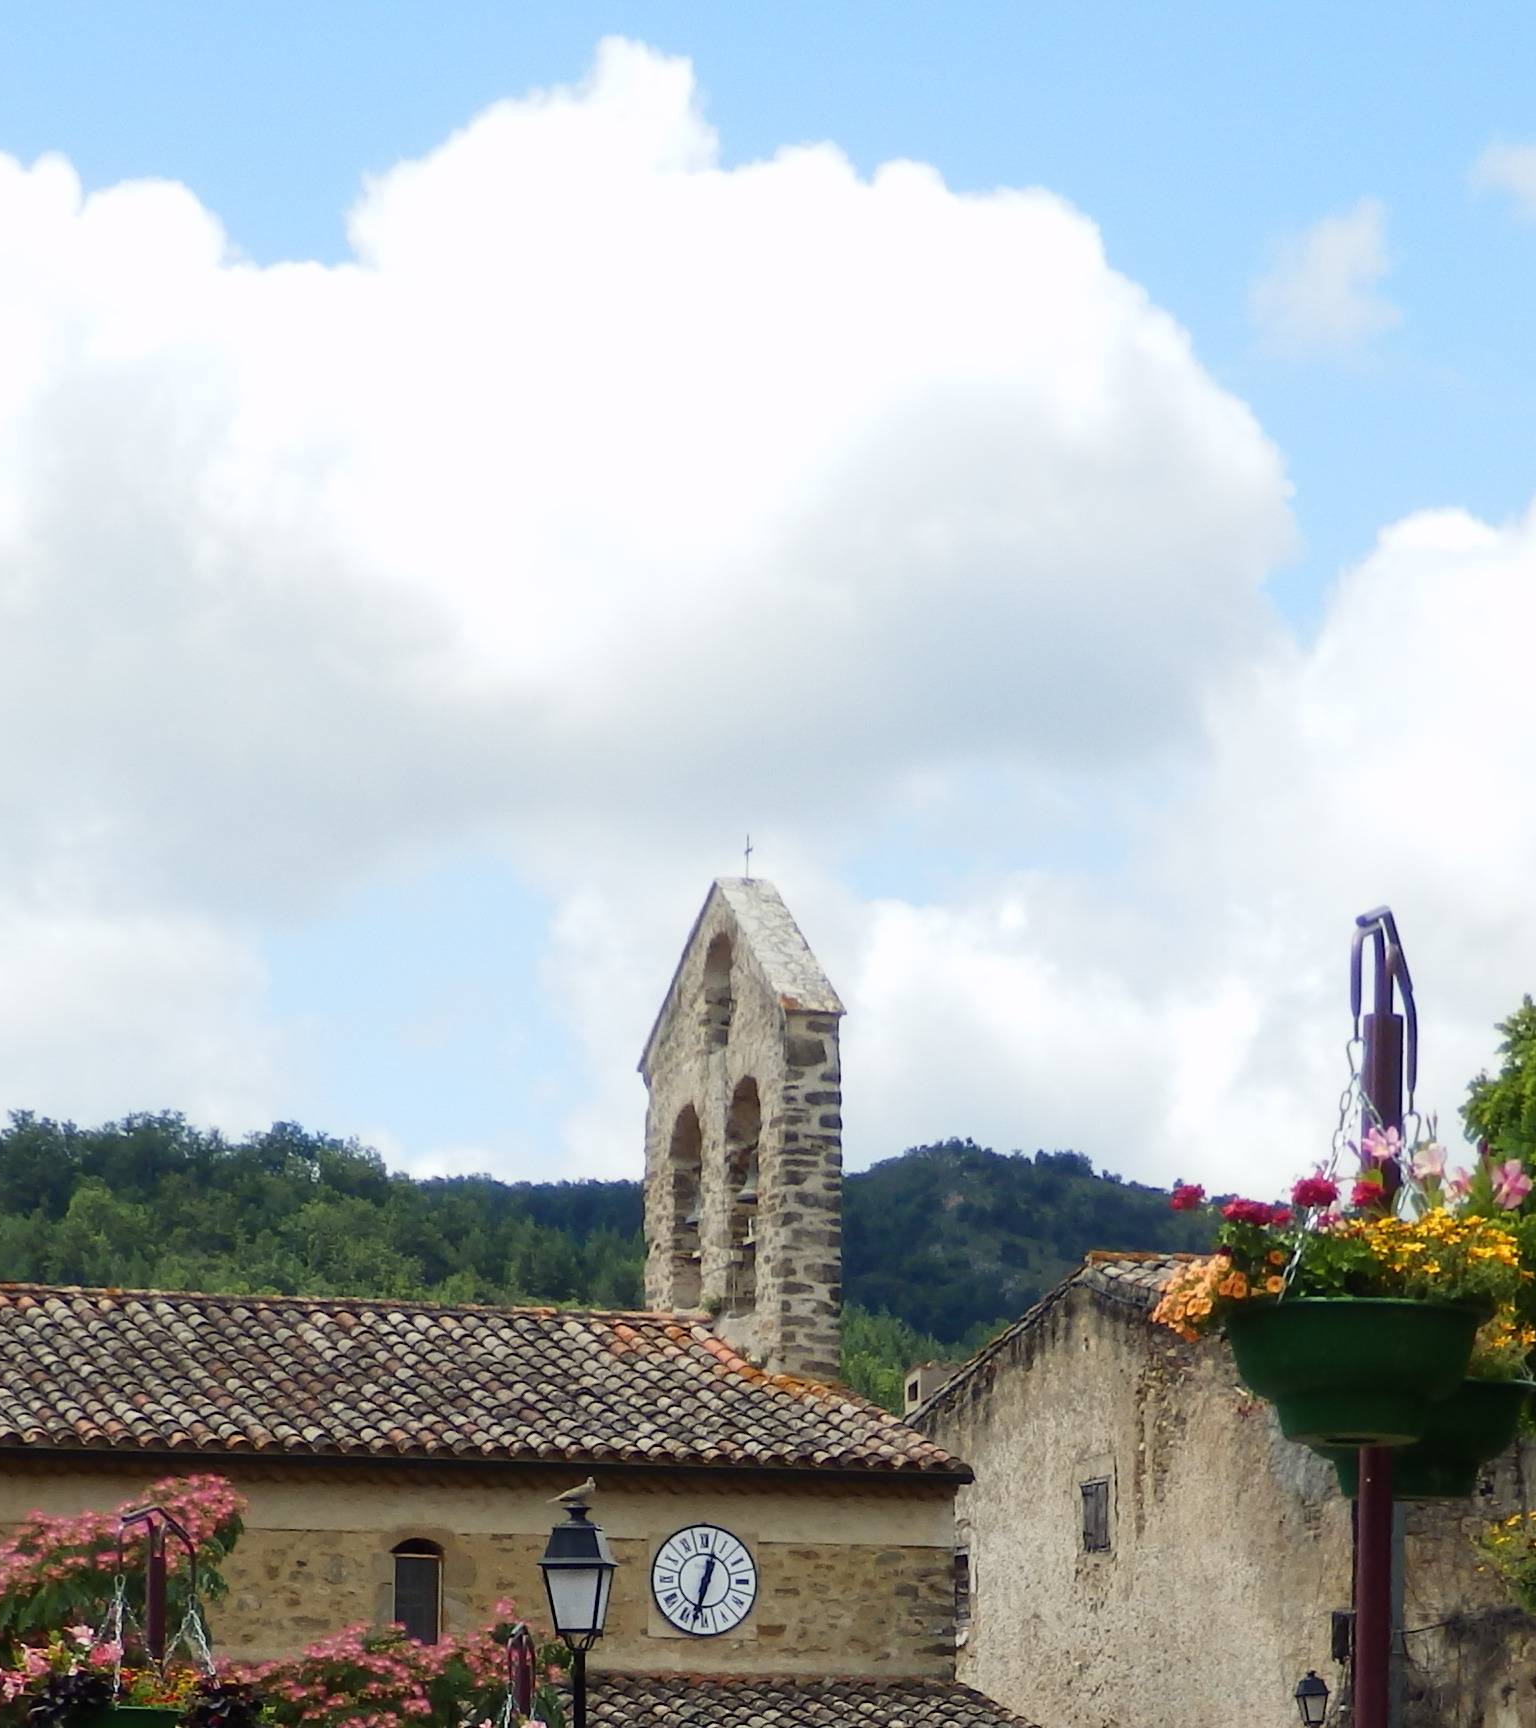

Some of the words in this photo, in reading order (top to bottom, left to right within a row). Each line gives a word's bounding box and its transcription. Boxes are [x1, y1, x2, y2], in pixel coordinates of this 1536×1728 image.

[719, 1540, 728, 1554] I
[665, 1554, 679, 1566] X
[720, 1610, 729, 1623] V
